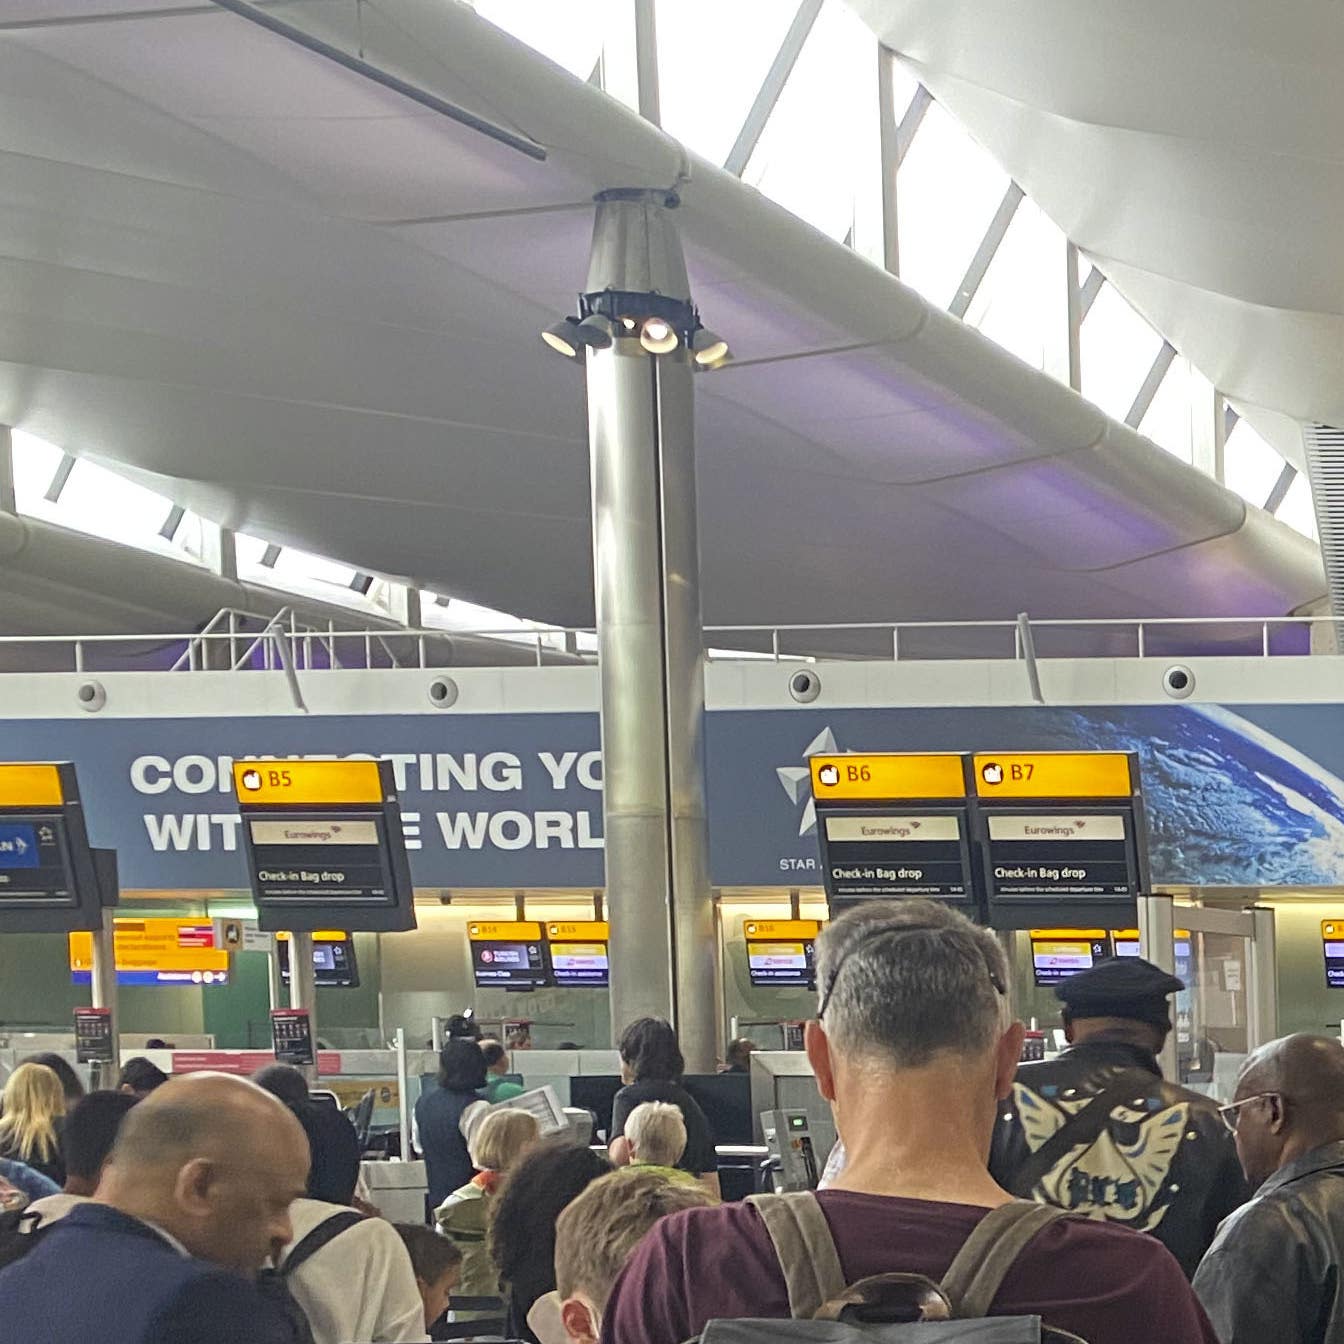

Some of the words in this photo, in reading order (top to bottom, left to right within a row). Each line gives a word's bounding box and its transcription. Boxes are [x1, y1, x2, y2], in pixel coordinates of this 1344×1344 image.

[130, 751, 523, 793] COTING
[537, 750, 605, 791] YO
[846, 764, 872, 782] B6
[1010, 763, 1035, 781] B7
[268, 770, 293, 788] B5
[143, 813, 242, 851] WIT
[436, 810, 605, 850] WORL
[284, 829, 332, 842] Eurowings
[860, 826, 911, 837] Eurowings
[1024, 825, 1076, 837] Eurowings
[780, 859, 816, 871] STAR
[258, 870, 300, 883] Check-in
[301, 871, 321, 885] Bag
[322, 870, 346, 885] drop
[831, 867, 876, 879] Check-in
[876, 868, 897, 881] Bag
[897, 867, 923, 881] drop
[994, 867, 1039, 879] Check-in
[1039, 867, 1060, 880] Bag
[1061, 866, 1087, 880] drop
